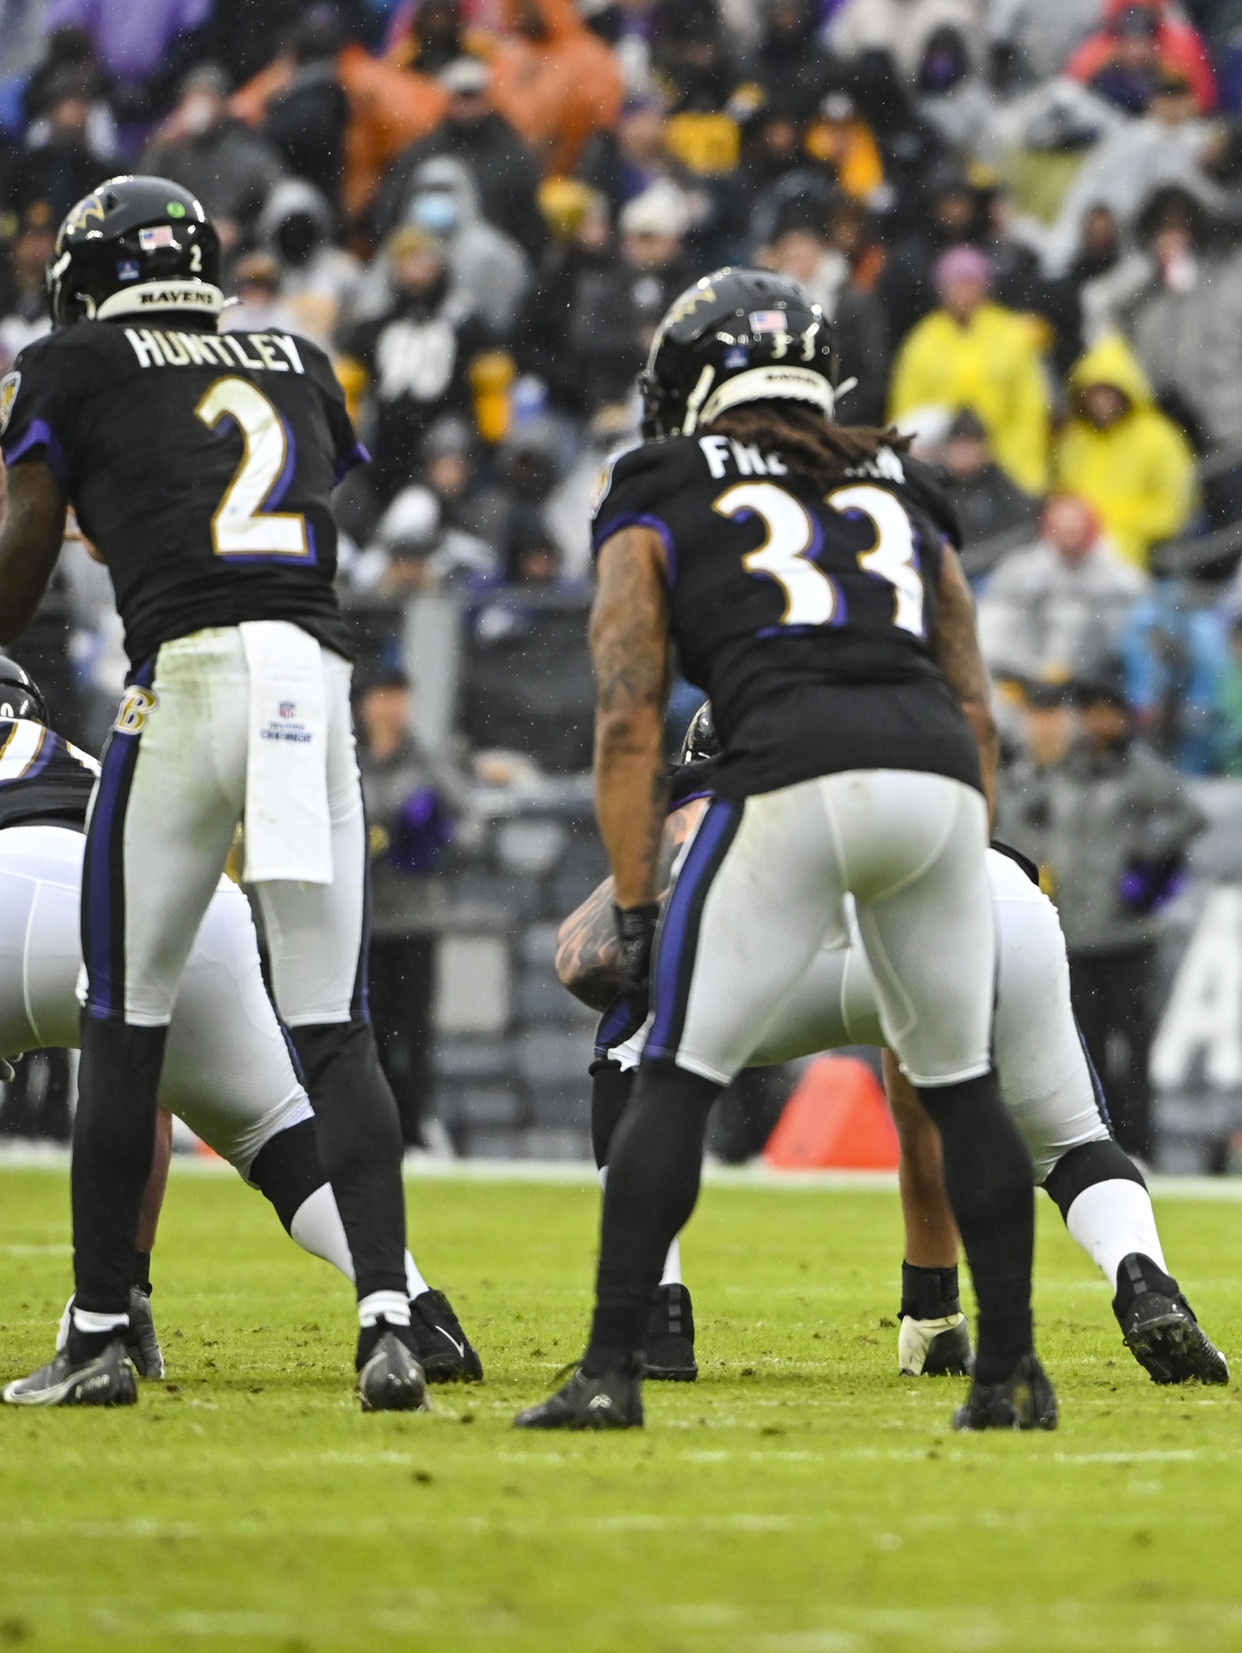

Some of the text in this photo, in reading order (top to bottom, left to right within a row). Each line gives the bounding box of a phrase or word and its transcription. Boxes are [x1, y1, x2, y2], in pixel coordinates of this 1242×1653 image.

[189, 243, 203, 272] 2
[140, 291, 214, 304] RAVENS
[124, 327, 305, 374] HUNTLEY
[194, 375, 318, 565] 2
[711, 480, 928, 638] 33
